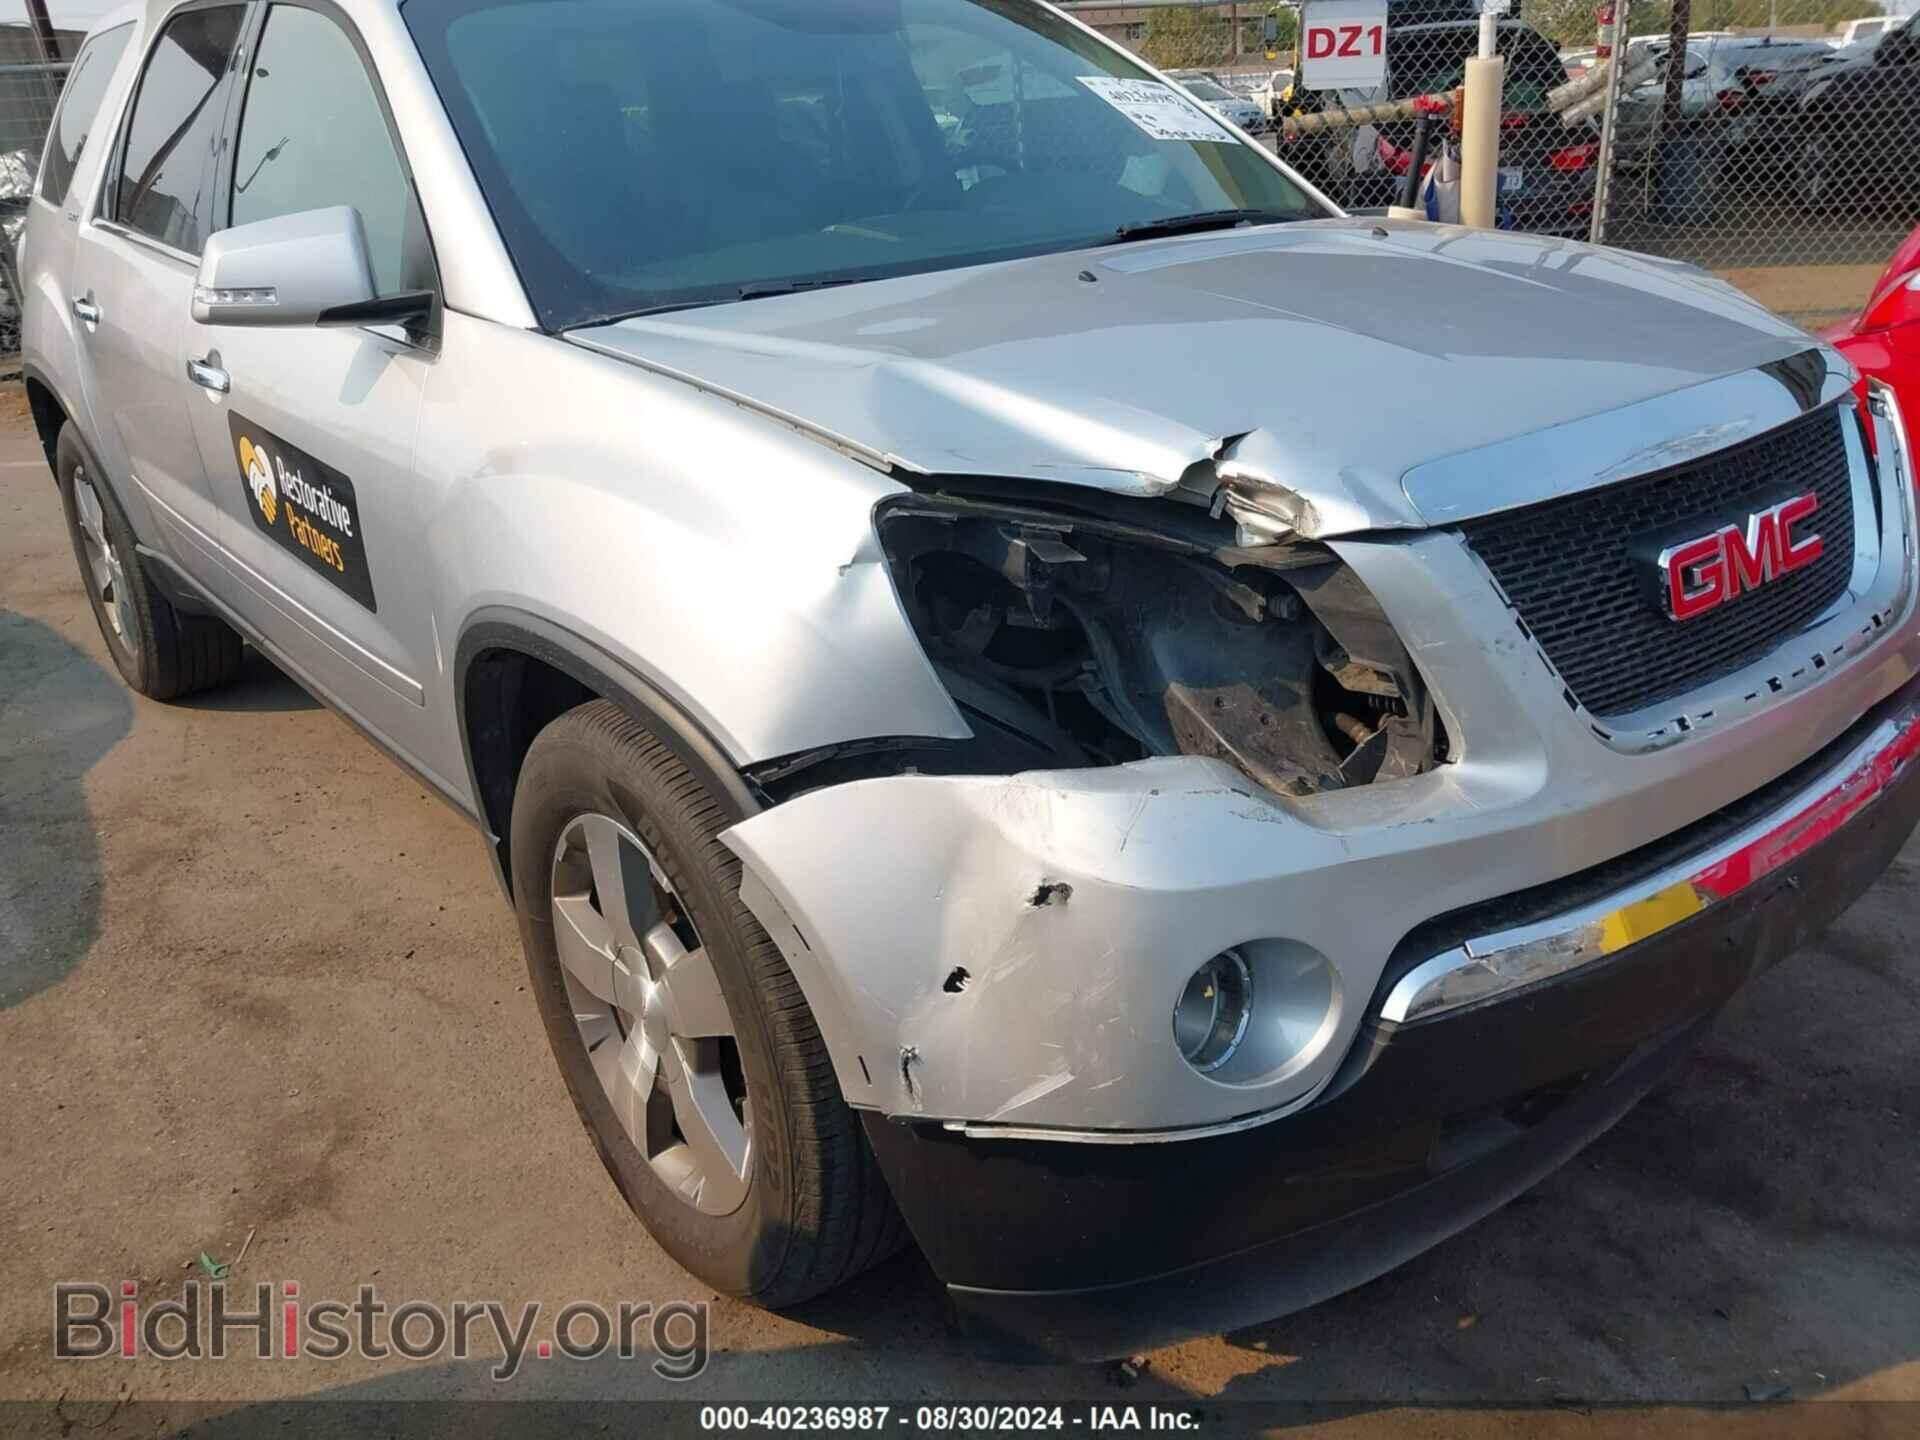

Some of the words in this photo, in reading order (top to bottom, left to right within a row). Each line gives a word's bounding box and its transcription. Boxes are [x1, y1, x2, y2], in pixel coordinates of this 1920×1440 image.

[1307, 25, 1382, 59] DZ1
[276, 455, 353, 537] Restorative
[284, 501, 345, 572] Partners
[1658, 491, 1824, 622] GMC
